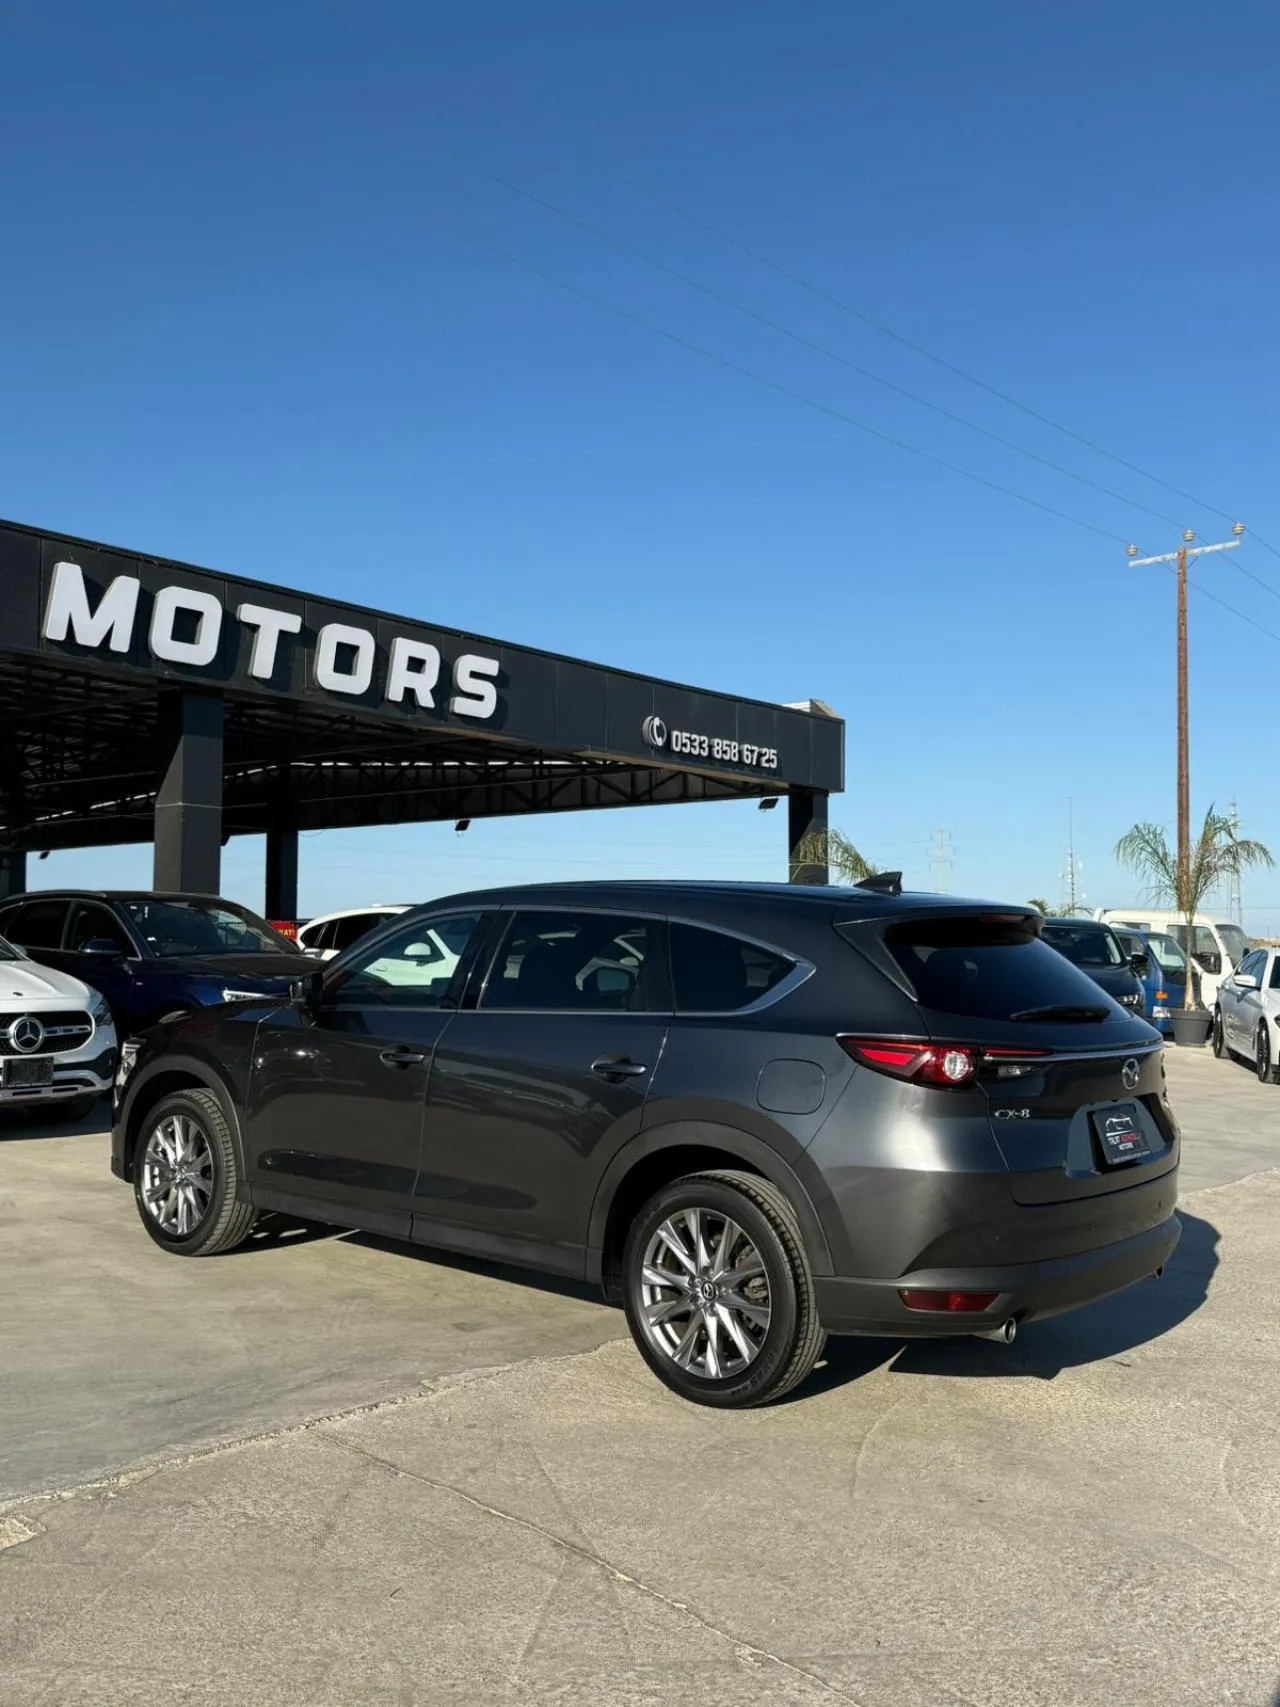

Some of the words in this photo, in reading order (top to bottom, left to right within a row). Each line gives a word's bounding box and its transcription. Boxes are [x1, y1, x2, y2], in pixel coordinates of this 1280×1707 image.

[42, 561, 500, 719] MOTORS
[672, 731, 708, 756] 0533
[713, 738, 739, 761] 858
[743, 744, 759, 765] 67
[761, 748, 777, 768] 25
[994, 1107, 1030, 1120] CX-8
